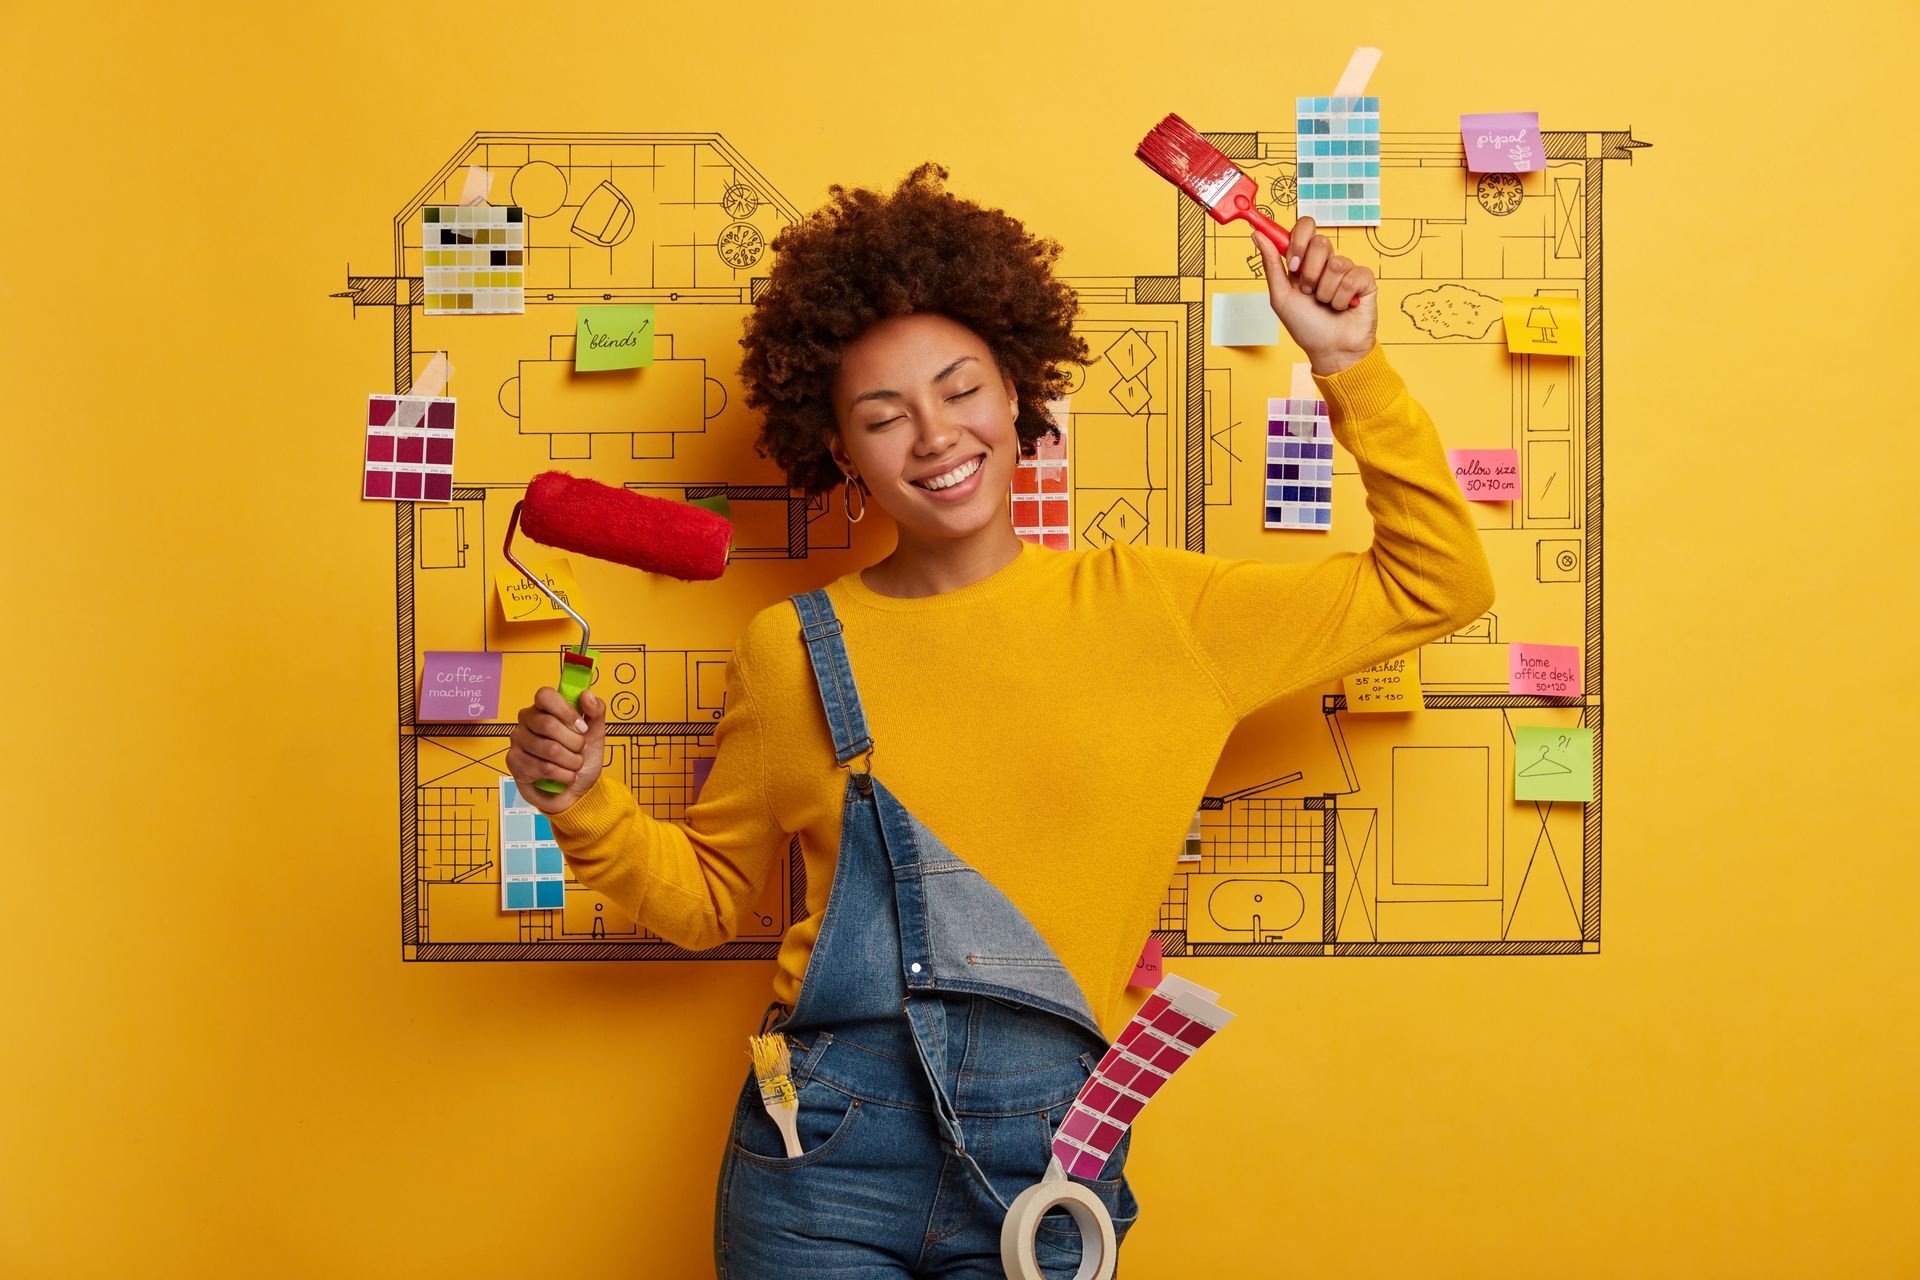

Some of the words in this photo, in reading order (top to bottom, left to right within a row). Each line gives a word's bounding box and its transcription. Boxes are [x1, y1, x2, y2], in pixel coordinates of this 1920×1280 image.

[589, 331, 637, 349] blinds
[1455, 459, 1491, 479] pillow
[1495, 463, 1517, 475] size
[1520, 652, 1551, 668] home
[437, 666, 492, 683] coffee-
[1355, 677, 1370, 685] 35
[1514, 668, 1547, 680] office
[1549, 667, 1575, 682] desk
[429, 686, 482, 697] machine
[1358, 694, 1371, 702] 45
